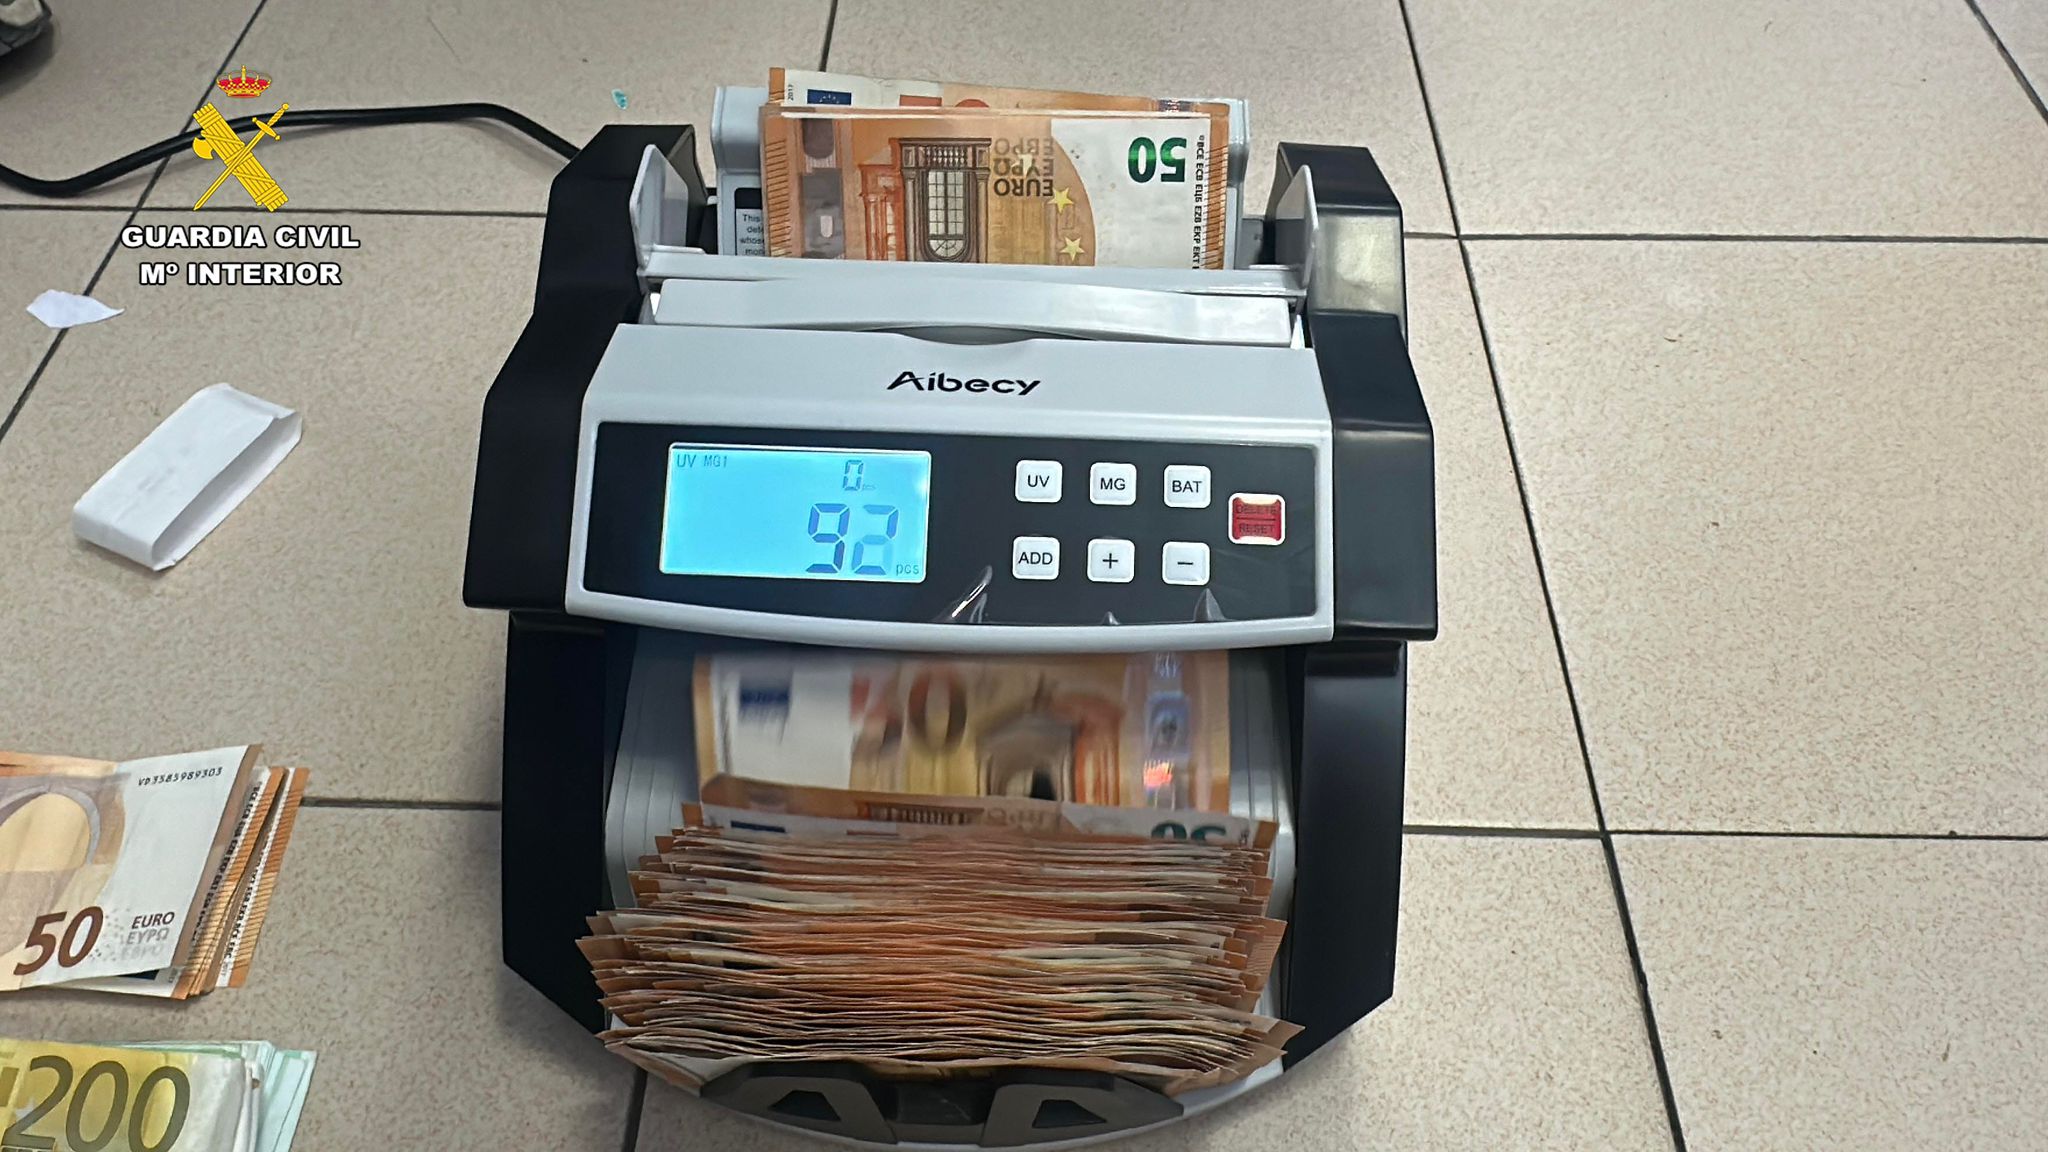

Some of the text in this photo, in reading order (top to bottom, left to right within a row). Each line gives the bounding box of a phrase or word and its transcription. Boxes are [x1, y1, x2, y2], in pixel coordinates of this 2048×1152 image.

[1127, 136, 1187, 183] 50
[994, 178, 1053, 196] EURO
[886, 371, 1041, 396] Aibecy
[677, 455, 728, 468] UV MG1
[842, 459, 864, 491] 0
[1027, 474, 1050, 488] UV
[1100, 477, 1126, 490] MG
[1172, 480, 1202, 493] BAT
[805, 502, 920, 576] 92 pcs
[1018, 552, 1053, 565] ADD
[131, 911, 175, 930] EURO
[13, 906, 104, 976] 50
[1, 1055, 191, 1152] 200
